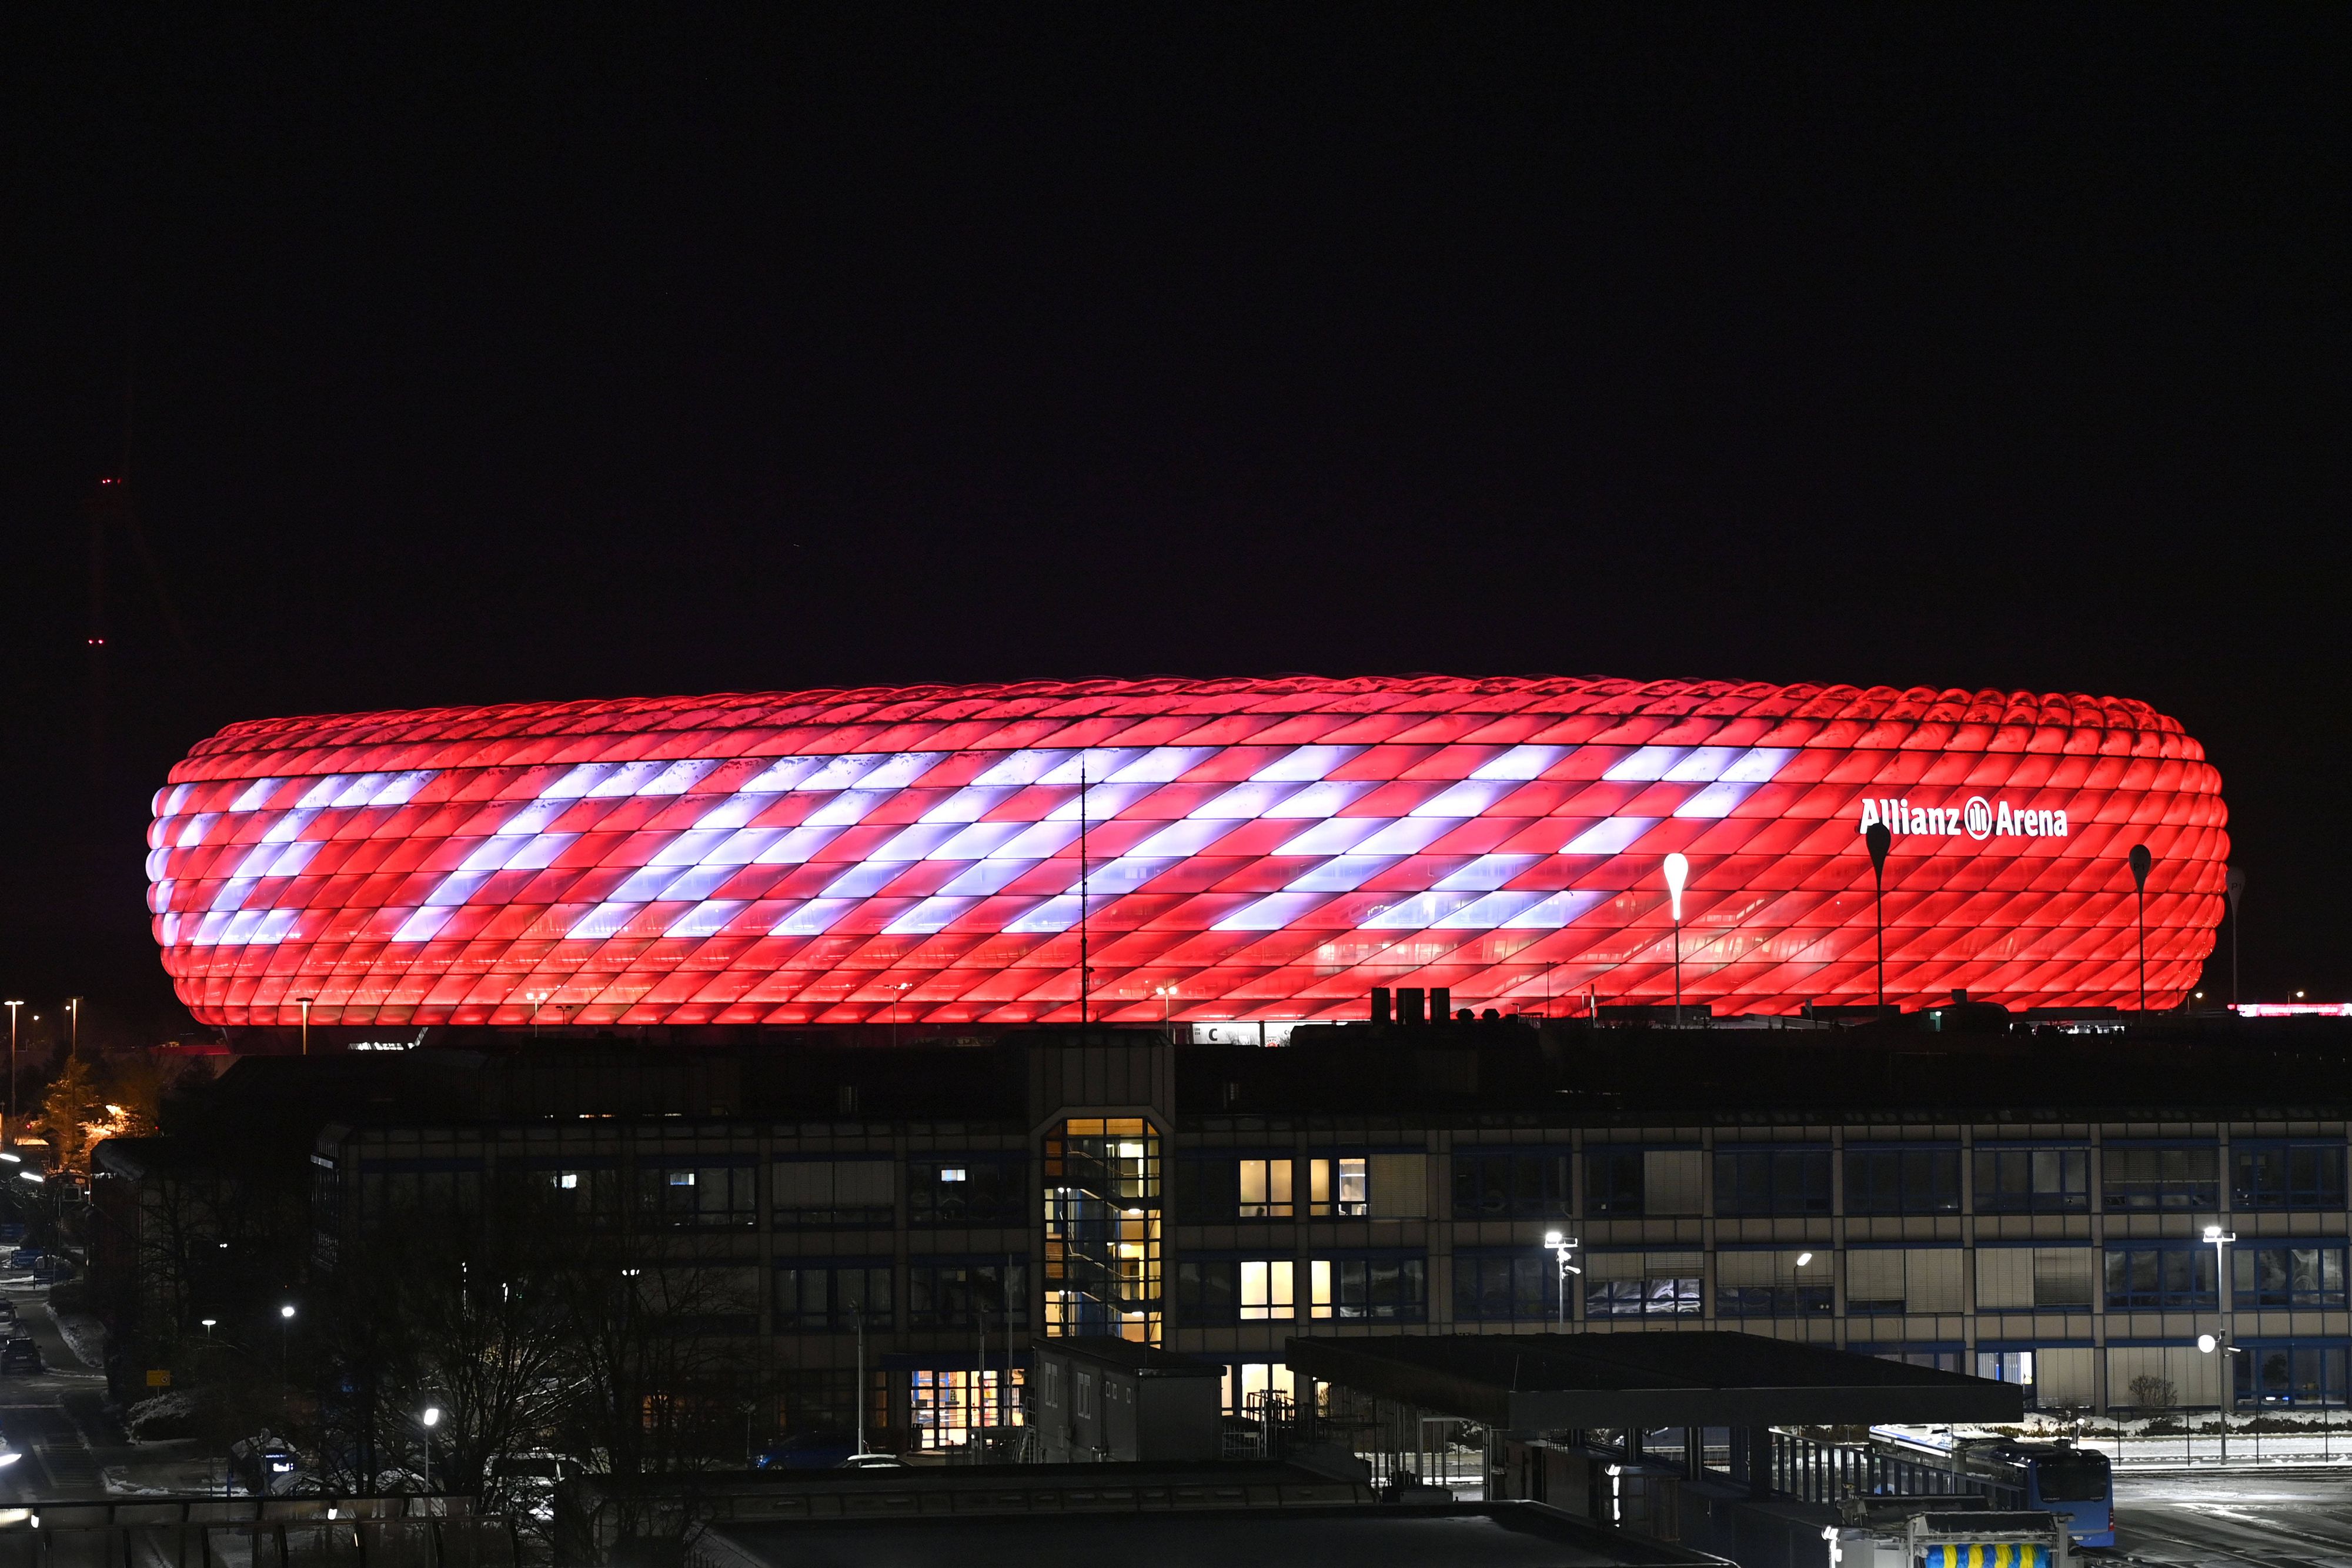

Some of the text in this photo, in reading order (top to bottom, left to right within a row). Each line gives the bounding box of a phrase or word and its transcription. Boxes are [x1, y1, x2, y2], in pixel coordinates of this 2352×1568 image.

[1859, 798, 2068, 837] Allianz Arena
[391, 745, 1803, 942] FRANZ
[1208, 1028, 1218, 1041] C
